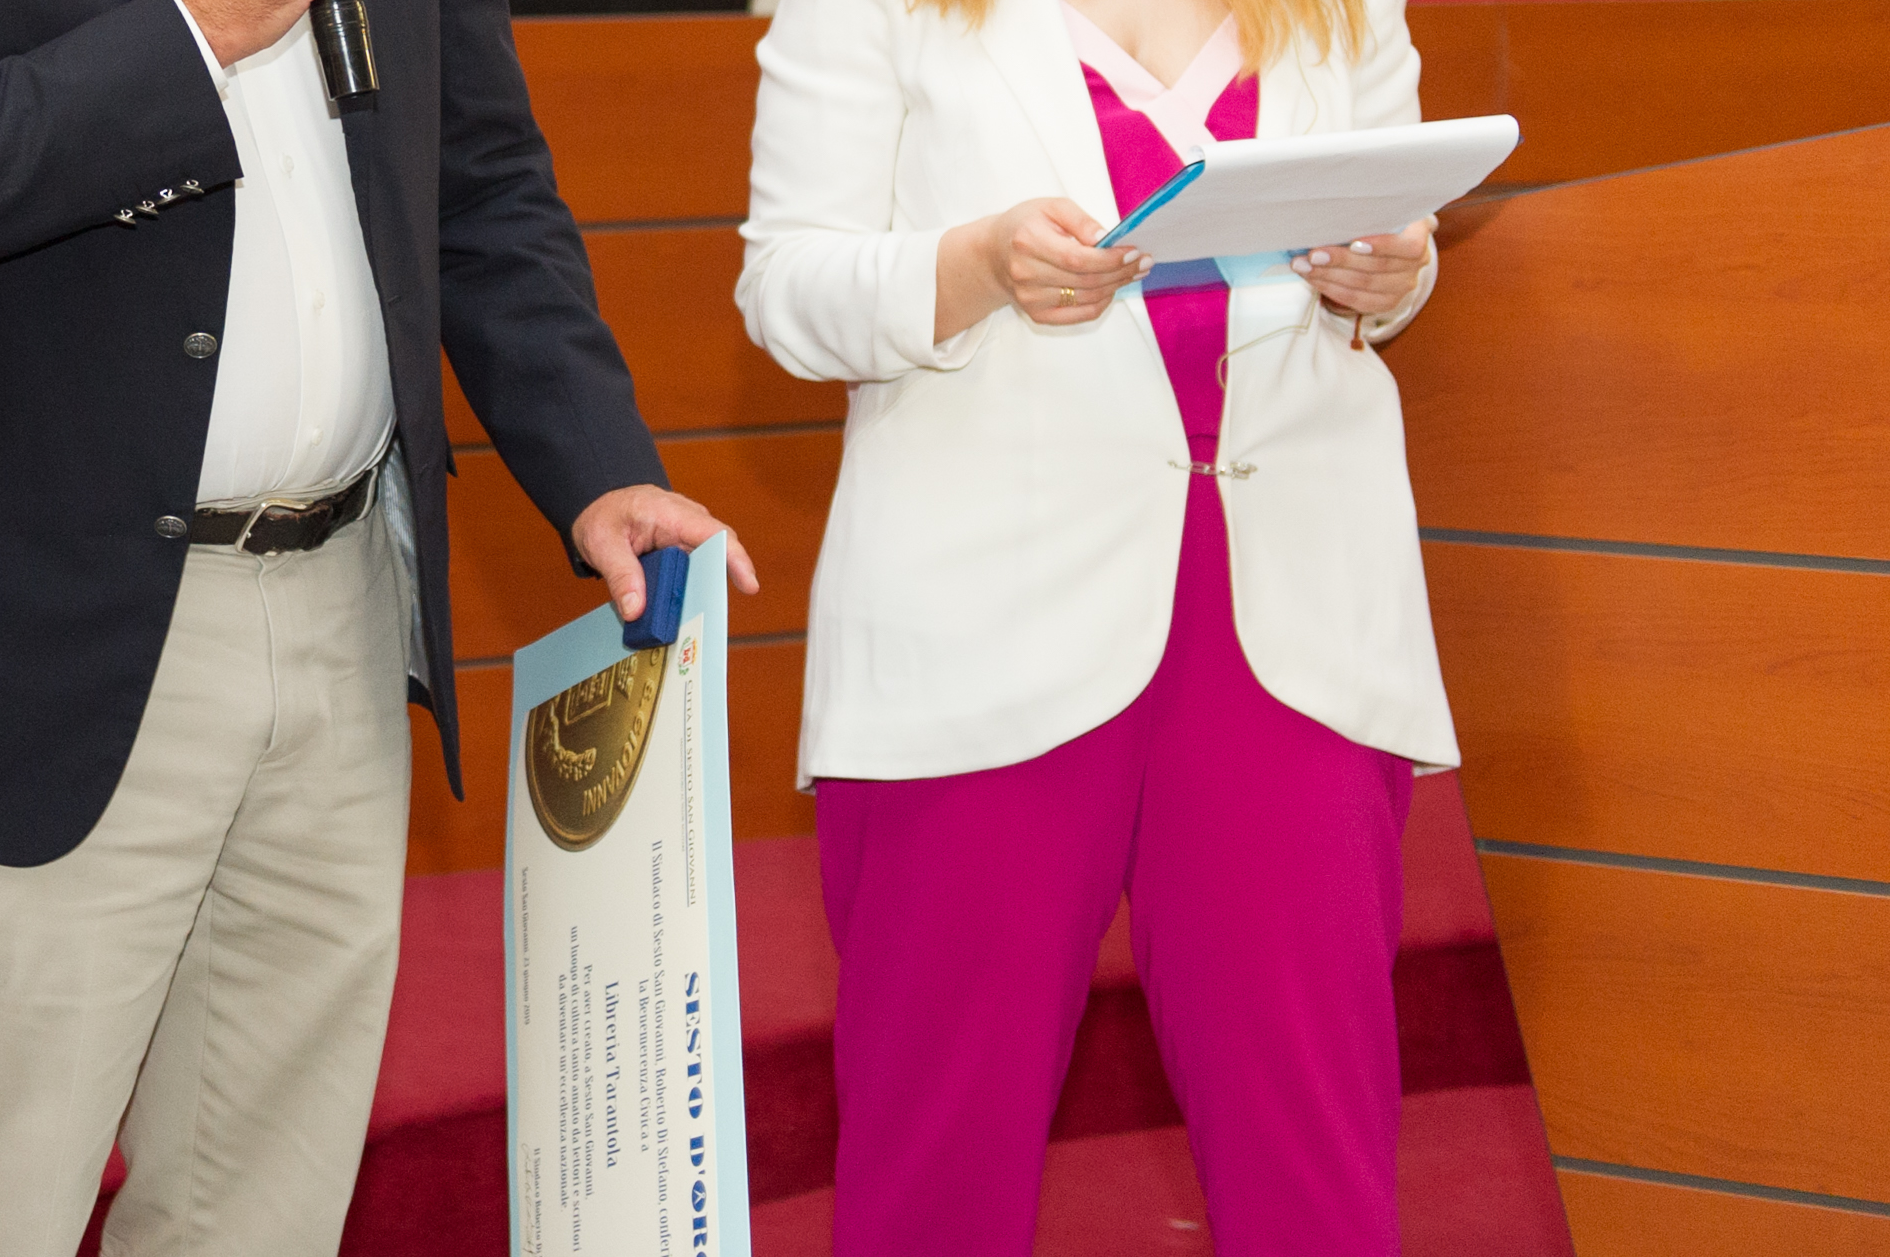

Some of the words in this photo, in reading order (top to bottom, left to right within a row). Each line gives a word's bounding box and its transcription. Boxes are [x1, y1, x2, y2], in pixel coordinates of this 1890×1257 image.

[652, 853, 663, 910] Sindaco
[571, 926, 579, 943] un
[653, 913, 664, 927] di
[570, 944, 580, 981] luogo
[653, 929, 665, 967] Sesto
[559, 974, 568, 990] da
[571, 984, 581, 996] di
[583, 964, 593, 985] Per
[639, 978, 650, 993] la
[654, 970, 666, 997] San
[559, 993, 569, 1051] diventare
[571, 999, 581, 1045] cultura
[583, 990, 591, 1015] aver
[605, 980, 620, 1063] Libreria
[583, 1020, 593, 1063] creato,
[639, 996, 650, 1093] Benemerenza
[654, 1000, 666, 1066] Giovanni,
[685, 972, 704, 1119] SESTO
[571, 1047, 580, 1081] tanto
[559, 1055, 569, 1142] un'eccellenza
[571, 1085, 580, 1124] amato
[584, 1075, 594, 1110] Sesto
[655, 1068, 667, 1125] Roberto
[572, 1128, 581, 1144] da
[584, 1113, 594, 1137] San
[606, 1066, 621, 1168] Tarantola
[640, 1097, 651, 1140] Civica
[656, 1129, 669, 1144] Di
[572, 1147, 582, 1186] lettori
[640, 1144, 649, 1152] a
[534, 1157, 542, 1198] Sindaco
[656, 1146, 669, 1205] Stefano,
[690, 1133, 708, 1257] D'OR
[535, 1200, 543, 1240] Roberto
[573, 1200, 583, 1252] scrittori
